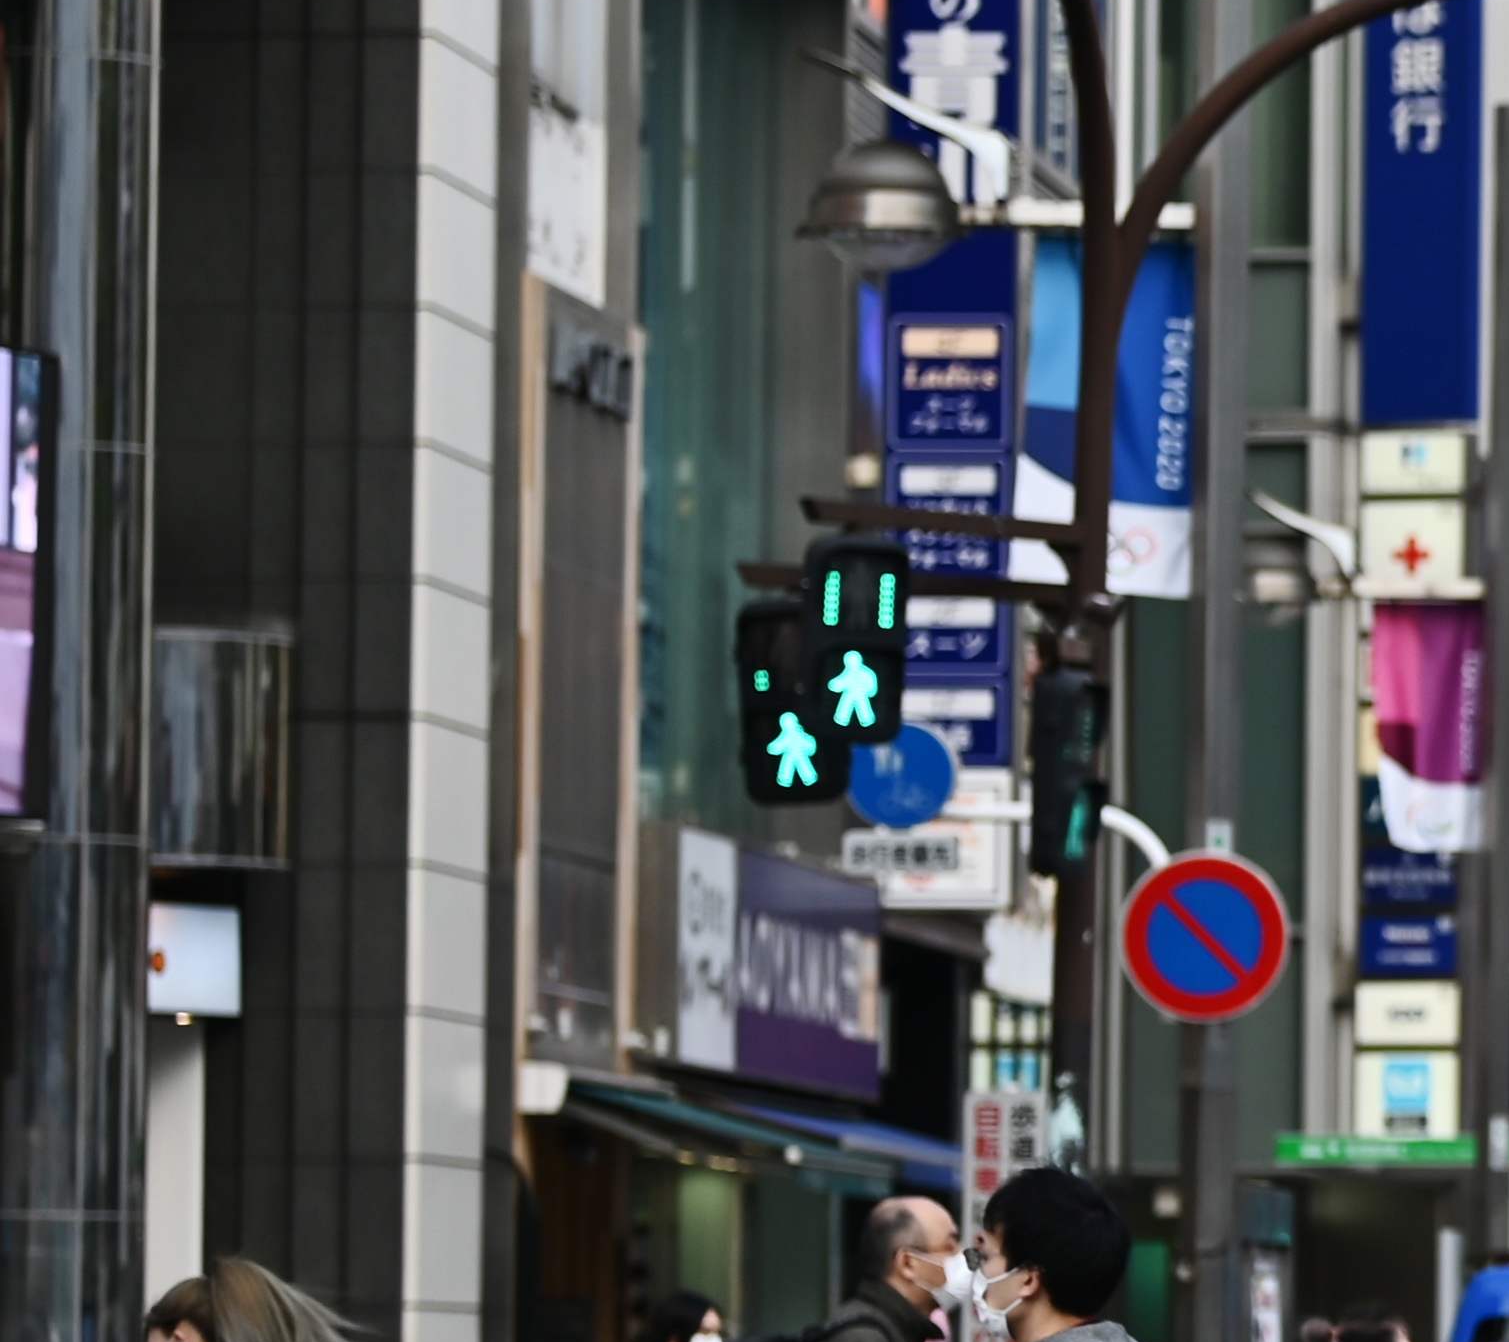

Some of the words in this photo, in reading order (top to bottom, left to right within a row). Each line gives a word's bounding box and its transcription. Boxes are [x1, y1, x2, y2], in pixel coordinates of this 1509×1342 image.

[902, 360, 998, 393] Ladies
[1160, 315, 1193, 414] TOKYO
[1155, 416, 1186, 491] 2020
